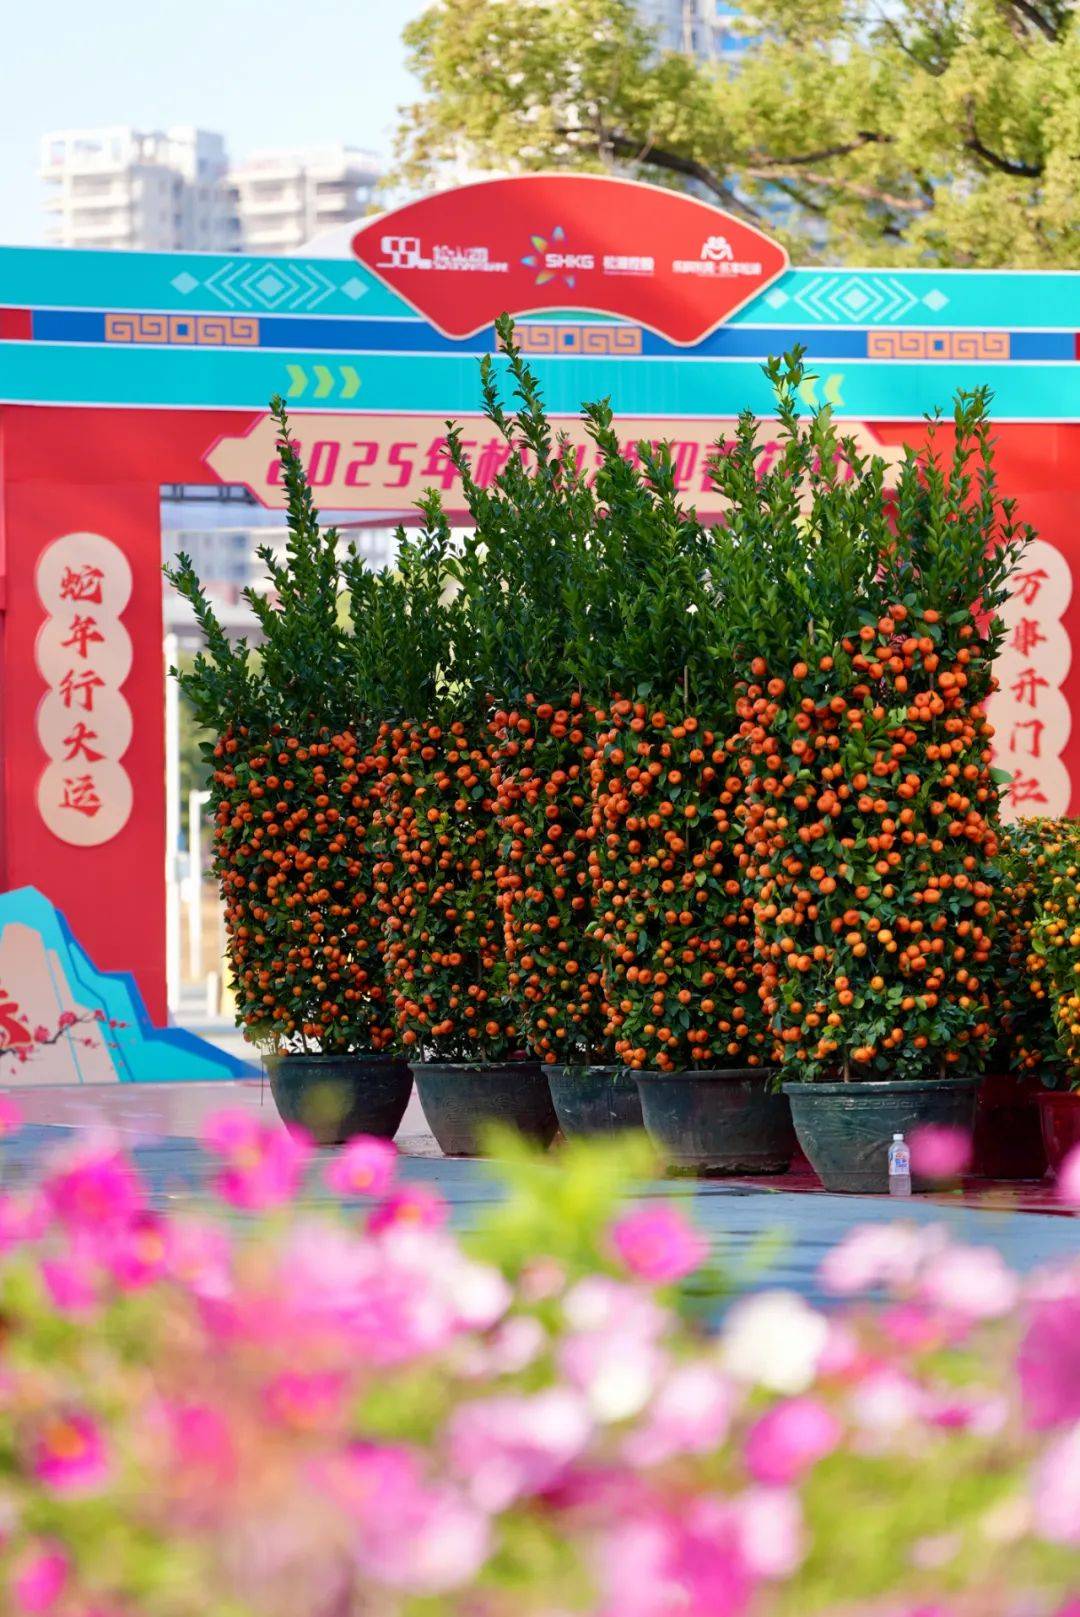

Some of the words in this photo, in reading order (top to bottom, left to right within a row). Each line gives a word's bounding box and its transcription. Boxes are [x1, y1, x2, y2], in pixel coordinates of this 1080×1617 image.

[545, 254, 595, 269] SHKG
[58, 565, 107, 818] 蛇年行大运
[1009, 568, 1051, 808] 万事开门红
